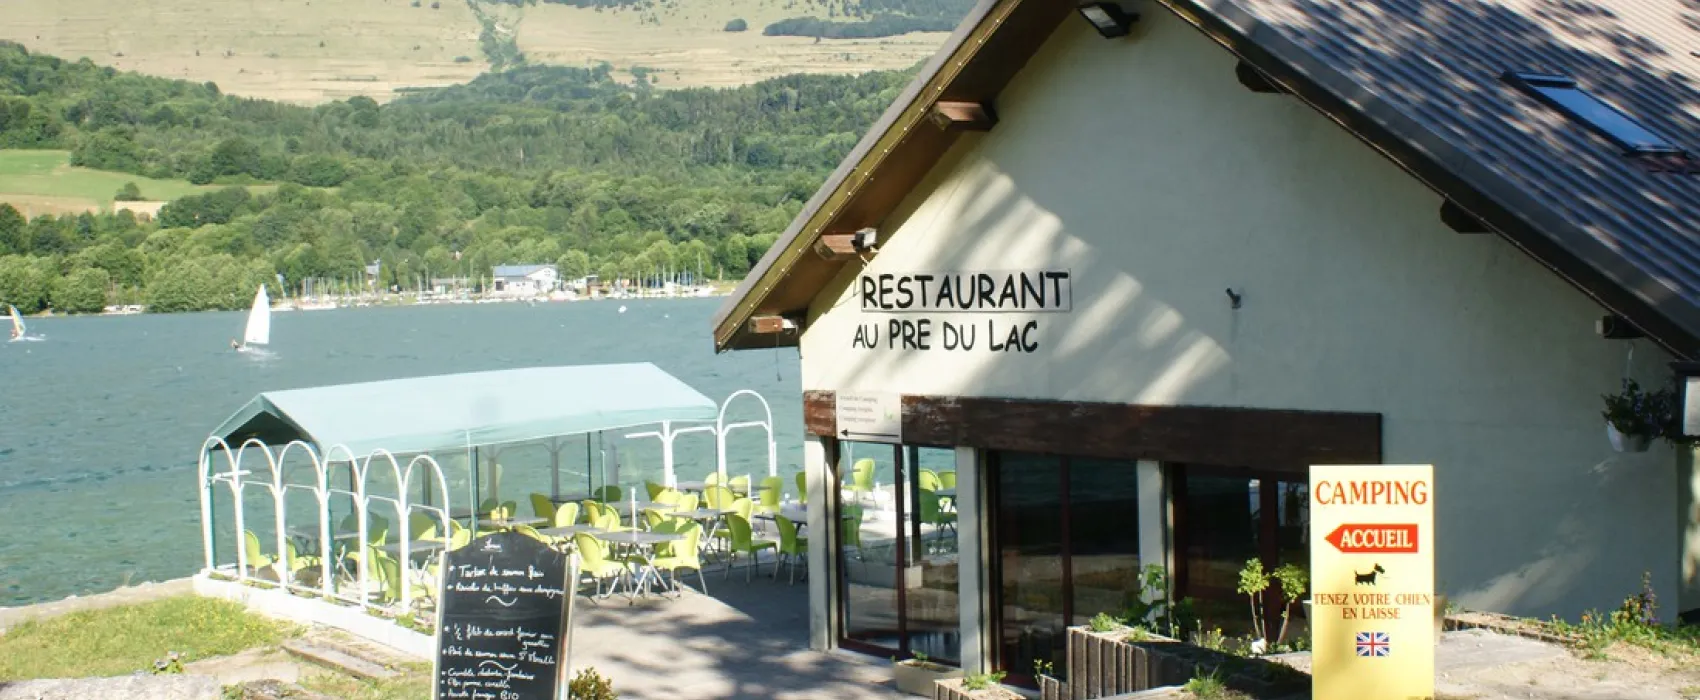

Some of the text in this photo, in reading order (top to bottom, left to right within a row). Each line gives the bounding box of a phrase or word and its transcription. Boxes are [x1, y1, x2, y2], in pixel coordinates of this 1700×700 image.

[862, 272, 1068, 309] RESTAURANT
[852, 318, 1038, 352] AU PRE DU LAC
[1315, 480, 1428, 505] CAMPING
[1340, 529, 1413, 549] ACCUEIL
[1314, 593, 1430, 606] TENEZ VOTRE CHIEN
[1342, 607, 1401, 620] EN LAISSE
